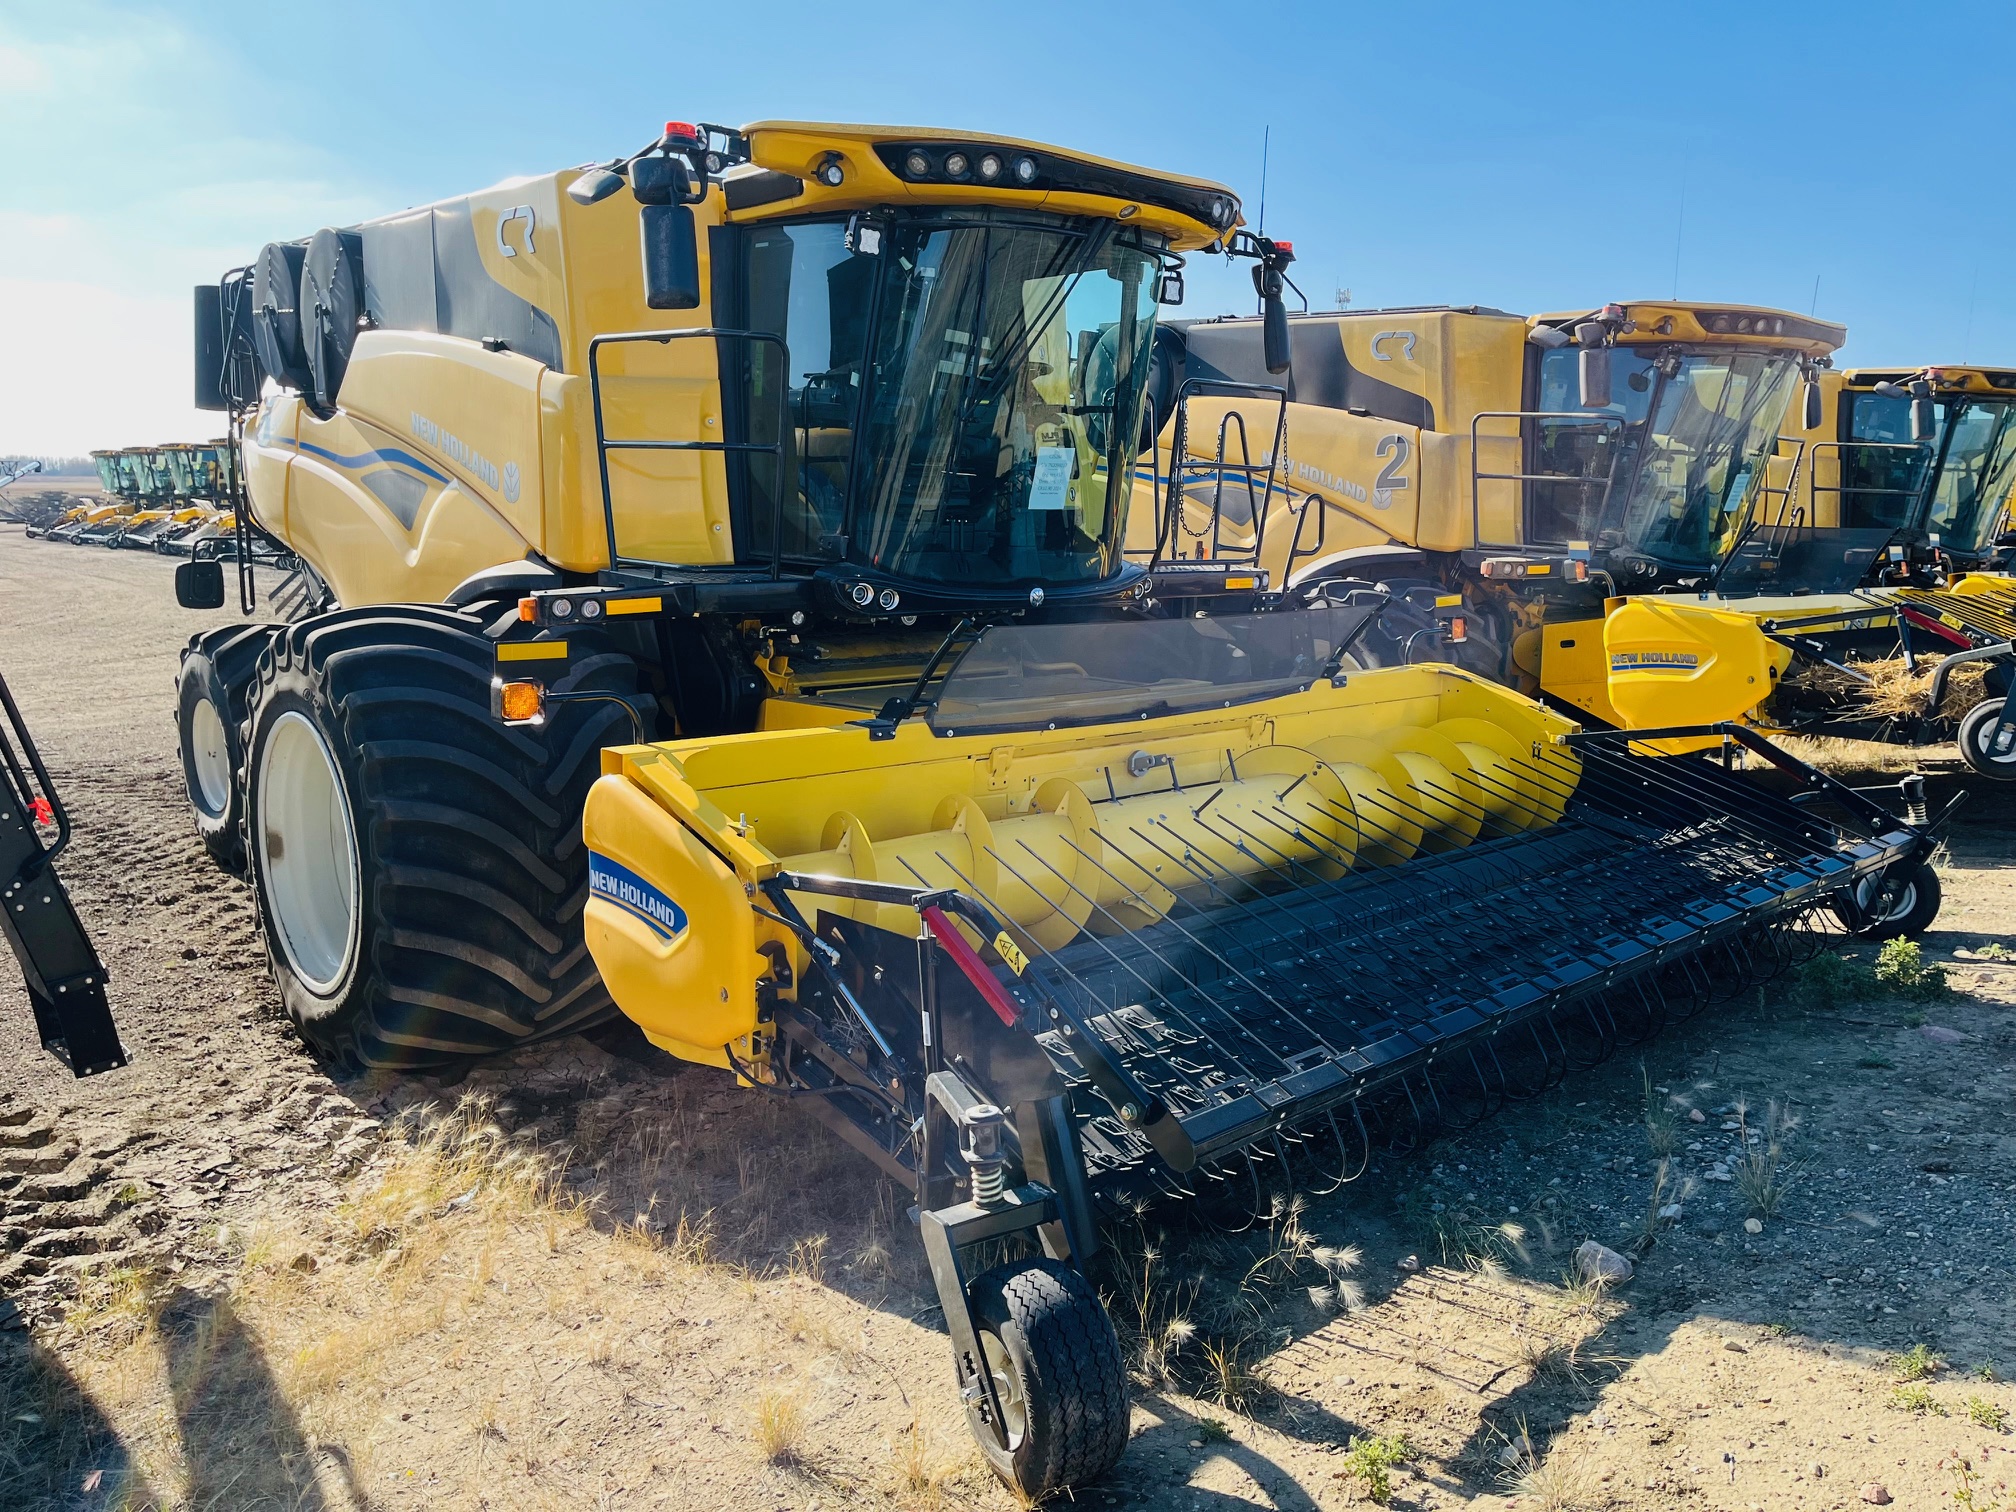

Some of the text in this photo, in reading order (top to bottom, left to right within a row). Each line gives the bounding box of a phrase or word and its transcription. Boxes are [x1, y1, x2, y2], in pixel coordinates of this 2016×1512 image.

[496, 205, 536, 258] CR
[1371, 330, 1416, 361] CR
[411, 411, 499, 492] NEW HOLLAND
[1261, 450, 1367, 503] NEW HOLLAND
[1375, 434, 1409, 490] 2
[1612, 652, 1698, 664] NEW HOLLAND
[590, 869, 675, 928] NEW HOLLAND
